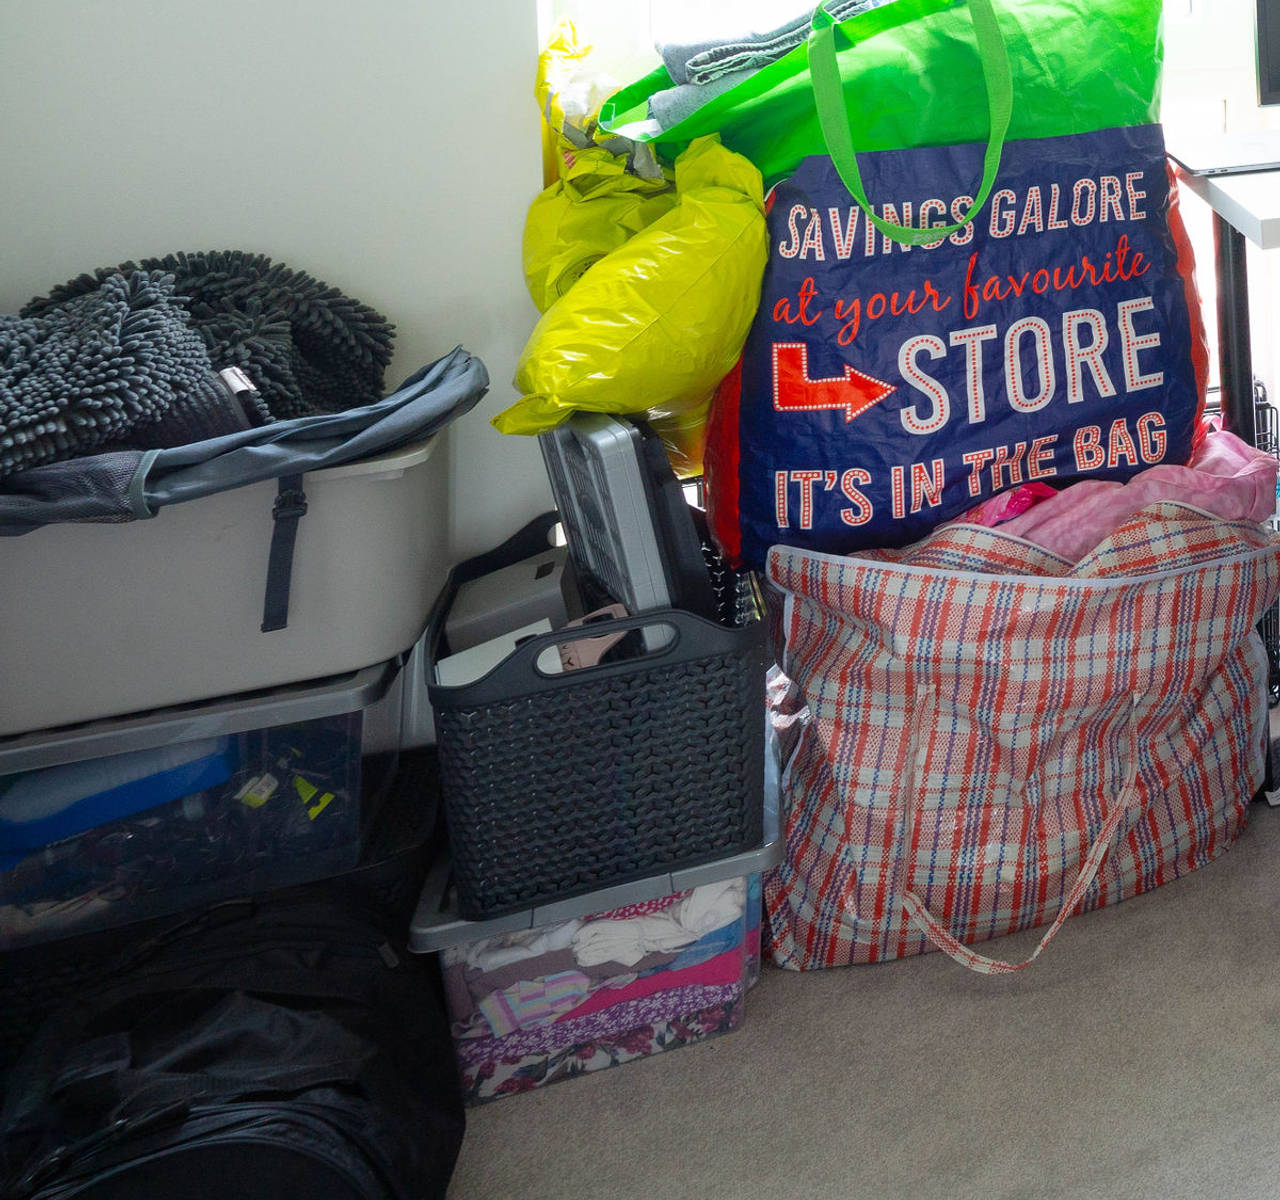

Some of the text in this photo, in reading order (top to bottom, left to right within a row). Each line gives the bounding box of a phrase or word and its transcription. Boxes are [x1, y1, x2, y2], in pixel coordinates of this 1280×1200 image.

[779, 170, 1147, 261] SAVINGS GALORE
[772, 234, 1151, 346] at your favourite
[898, 296, 1164, 435] STORE
[775, 411, 1168, 530] IT'S IN THE BAG
